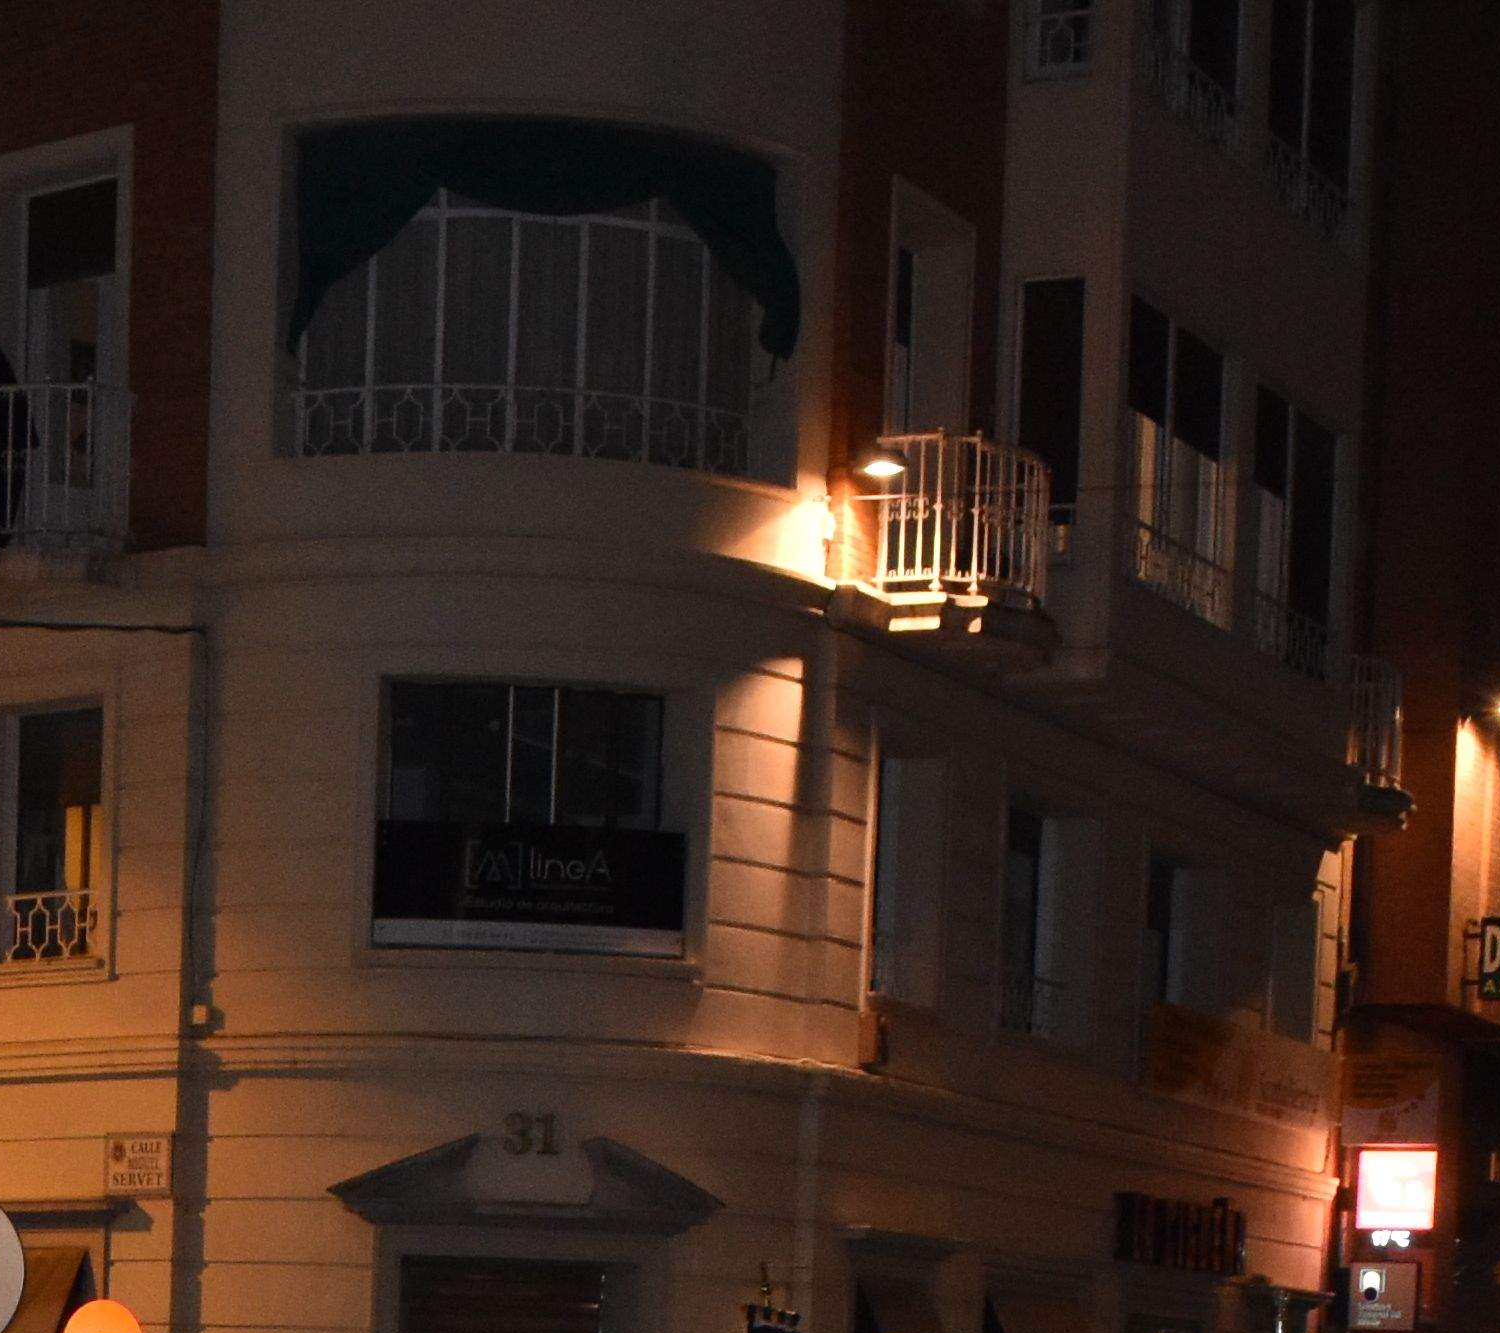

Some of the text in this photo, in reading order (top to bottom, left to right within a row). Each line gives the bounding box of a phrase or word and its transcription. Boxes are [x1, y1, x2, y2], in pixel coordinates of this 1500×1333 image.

[504, 1112, 560, 1155] 31
[131, 1141, 162, 1154] CALLE
[112, 1172, 163, 1186] SERVET
